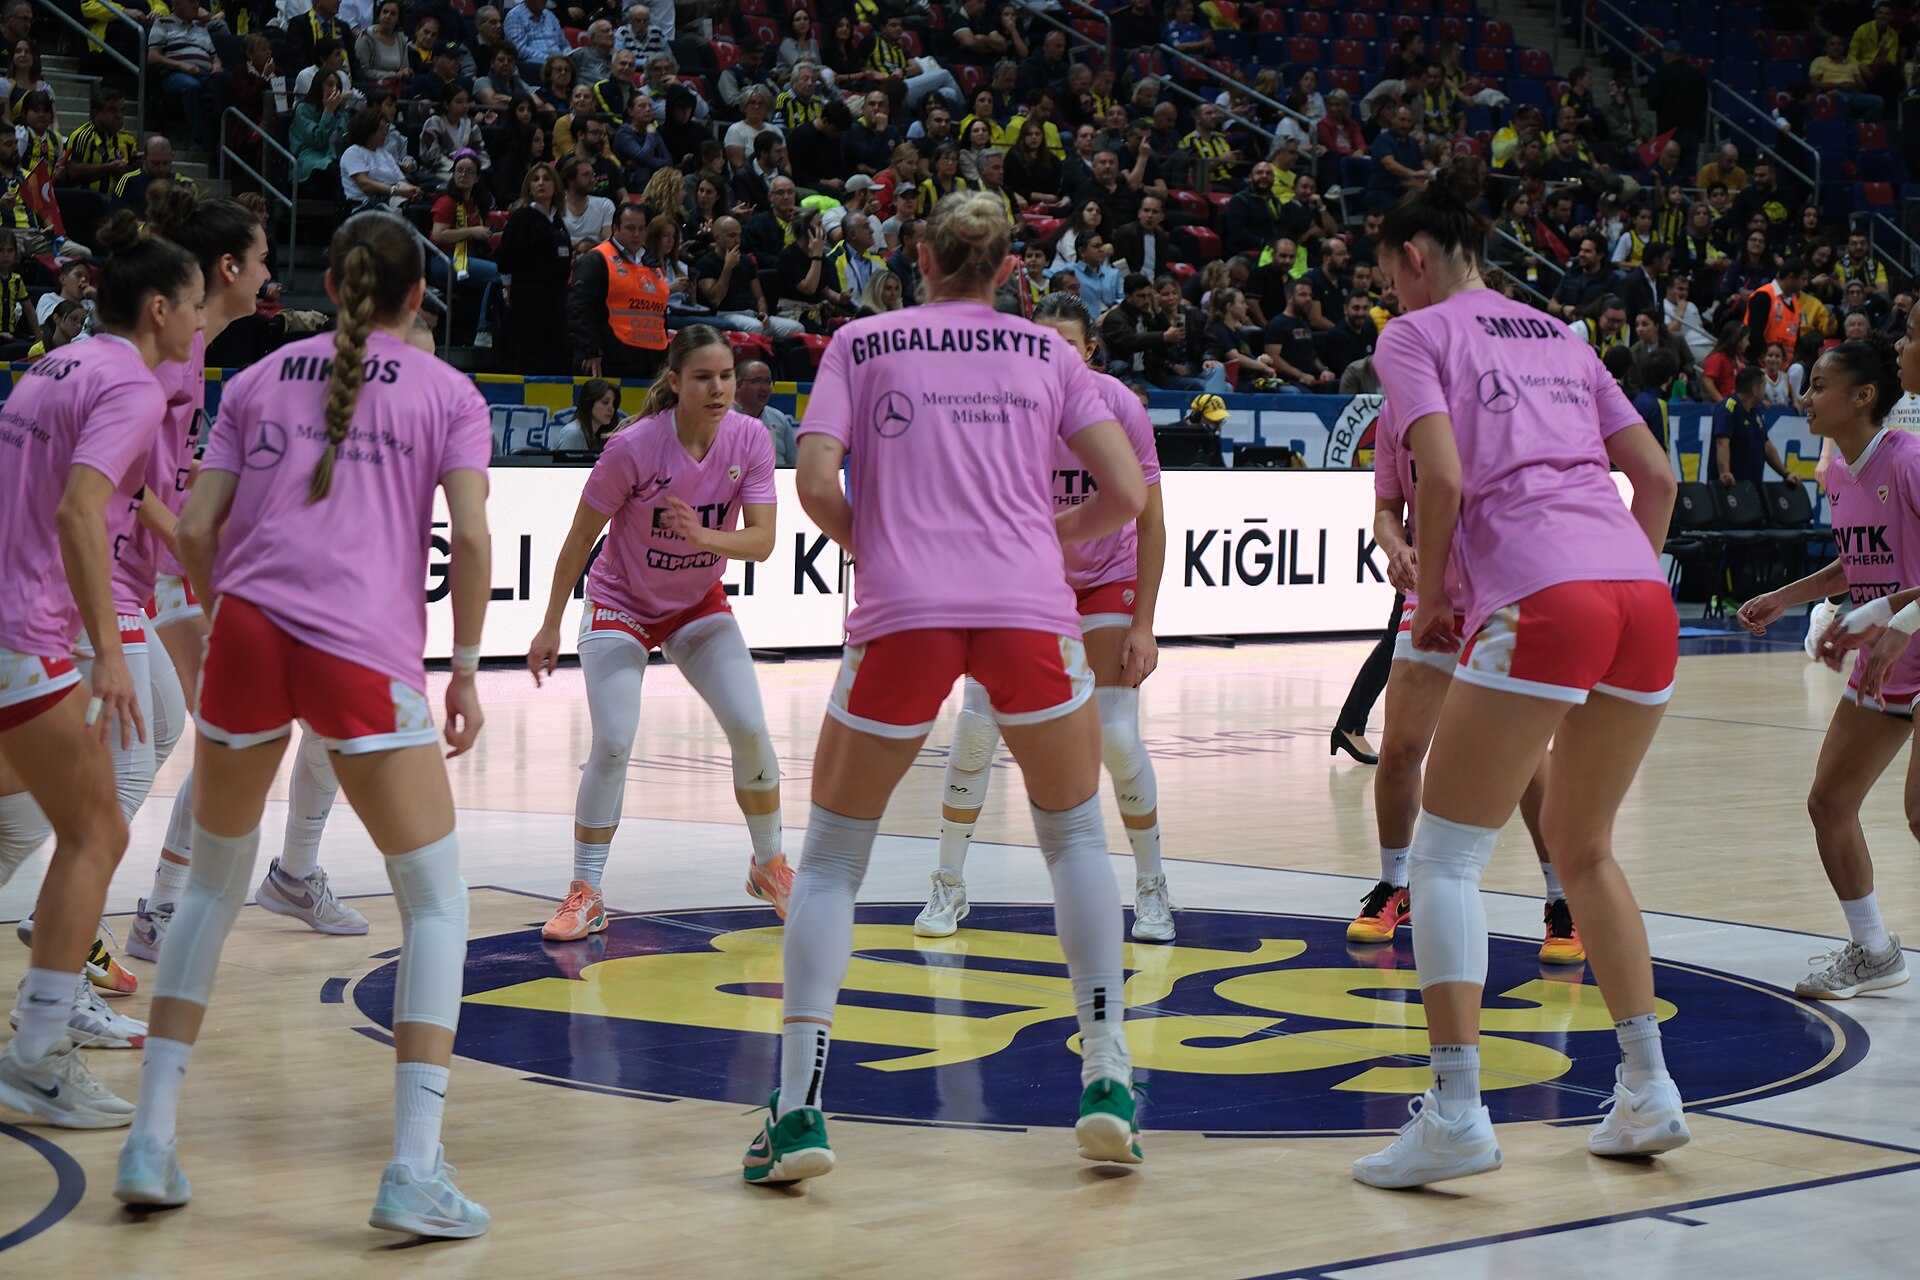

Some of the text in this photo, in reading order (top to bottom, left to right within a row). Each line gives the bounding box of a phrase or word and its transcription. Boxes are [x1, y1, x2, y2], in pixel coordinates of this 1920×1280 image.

[1475, 315, 1566, 340] SMUDA
[279, 354, 401, 384] MIKÓS
[922, 392, 1039, 421] Mercedes-Benz
